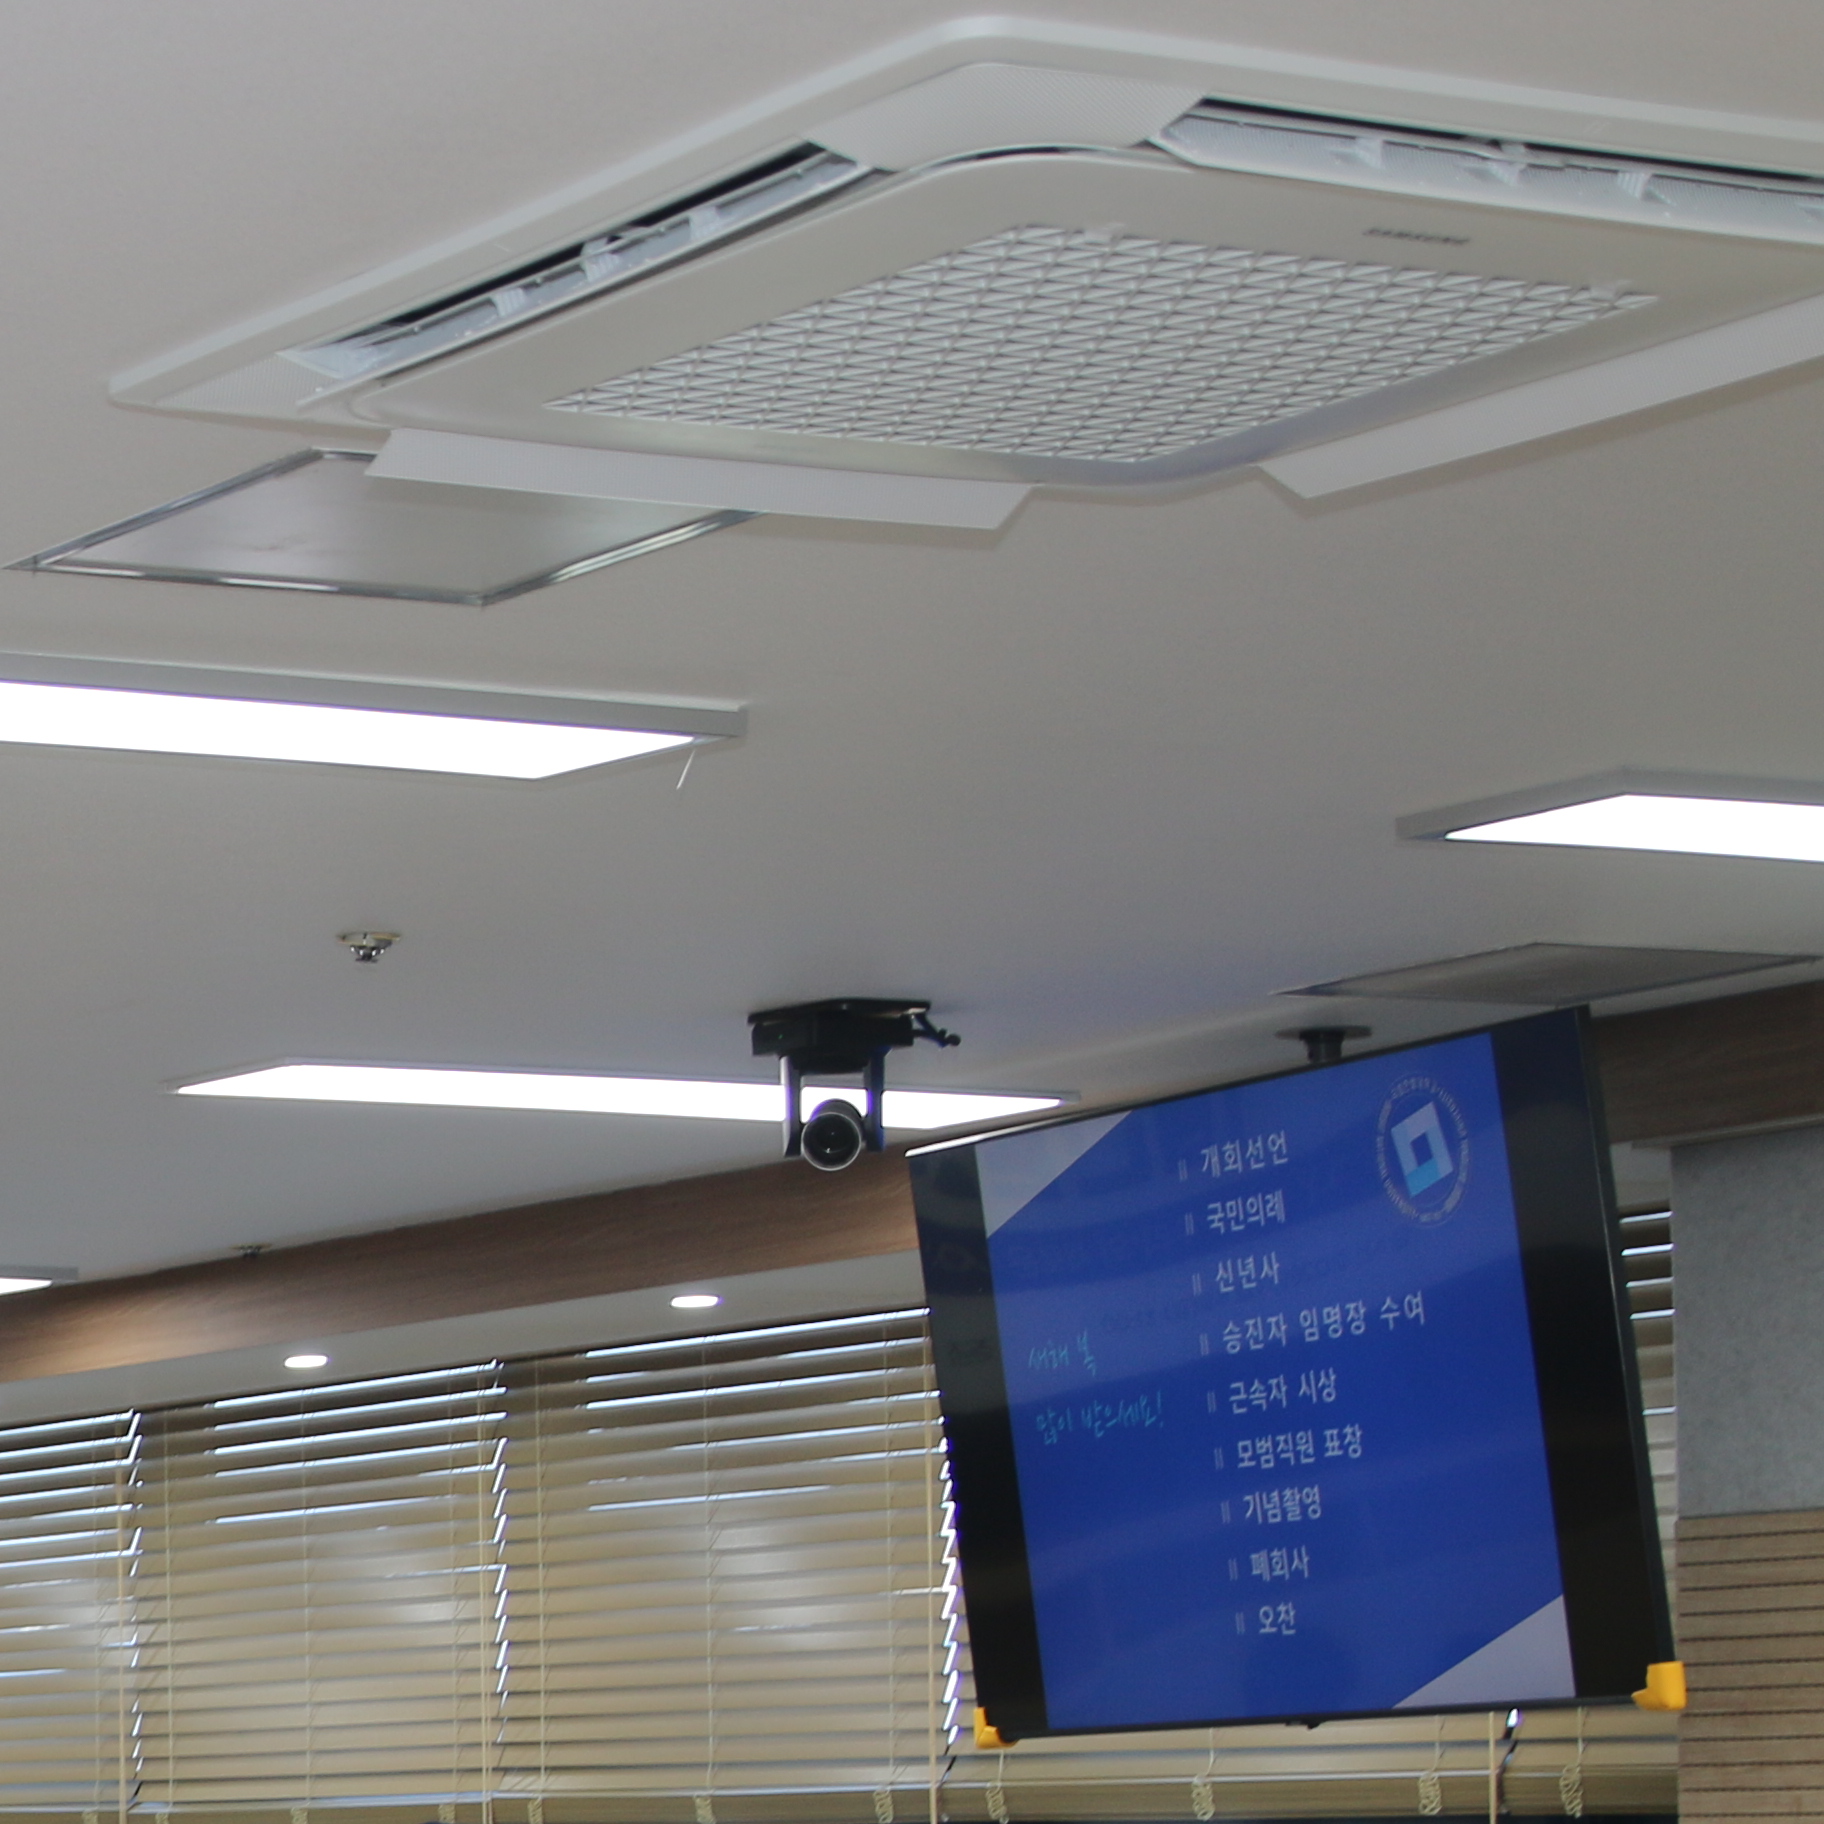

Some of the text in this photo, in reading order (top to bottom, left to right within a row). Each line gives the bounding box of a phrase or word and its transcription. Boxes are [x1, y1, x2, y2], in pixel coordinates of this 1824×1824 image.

[1201, 1130, 1288, 1177] 개회선언
[1206, 1189, 1285, 1233] 국민의례
[1216, 1251, 1280, 1293] 신년사
[1223, 1290, 1425, 1354] 승진자 임명장 수여
[1229, 1367, 1337, 1415] 근속자 시상
[1237, 1423, 1363, 1469] 모범직원 표창
[1243, 1484, 1322, 1524] 기념촬영
[1259, 1602, 1296, 1635] 오찬
